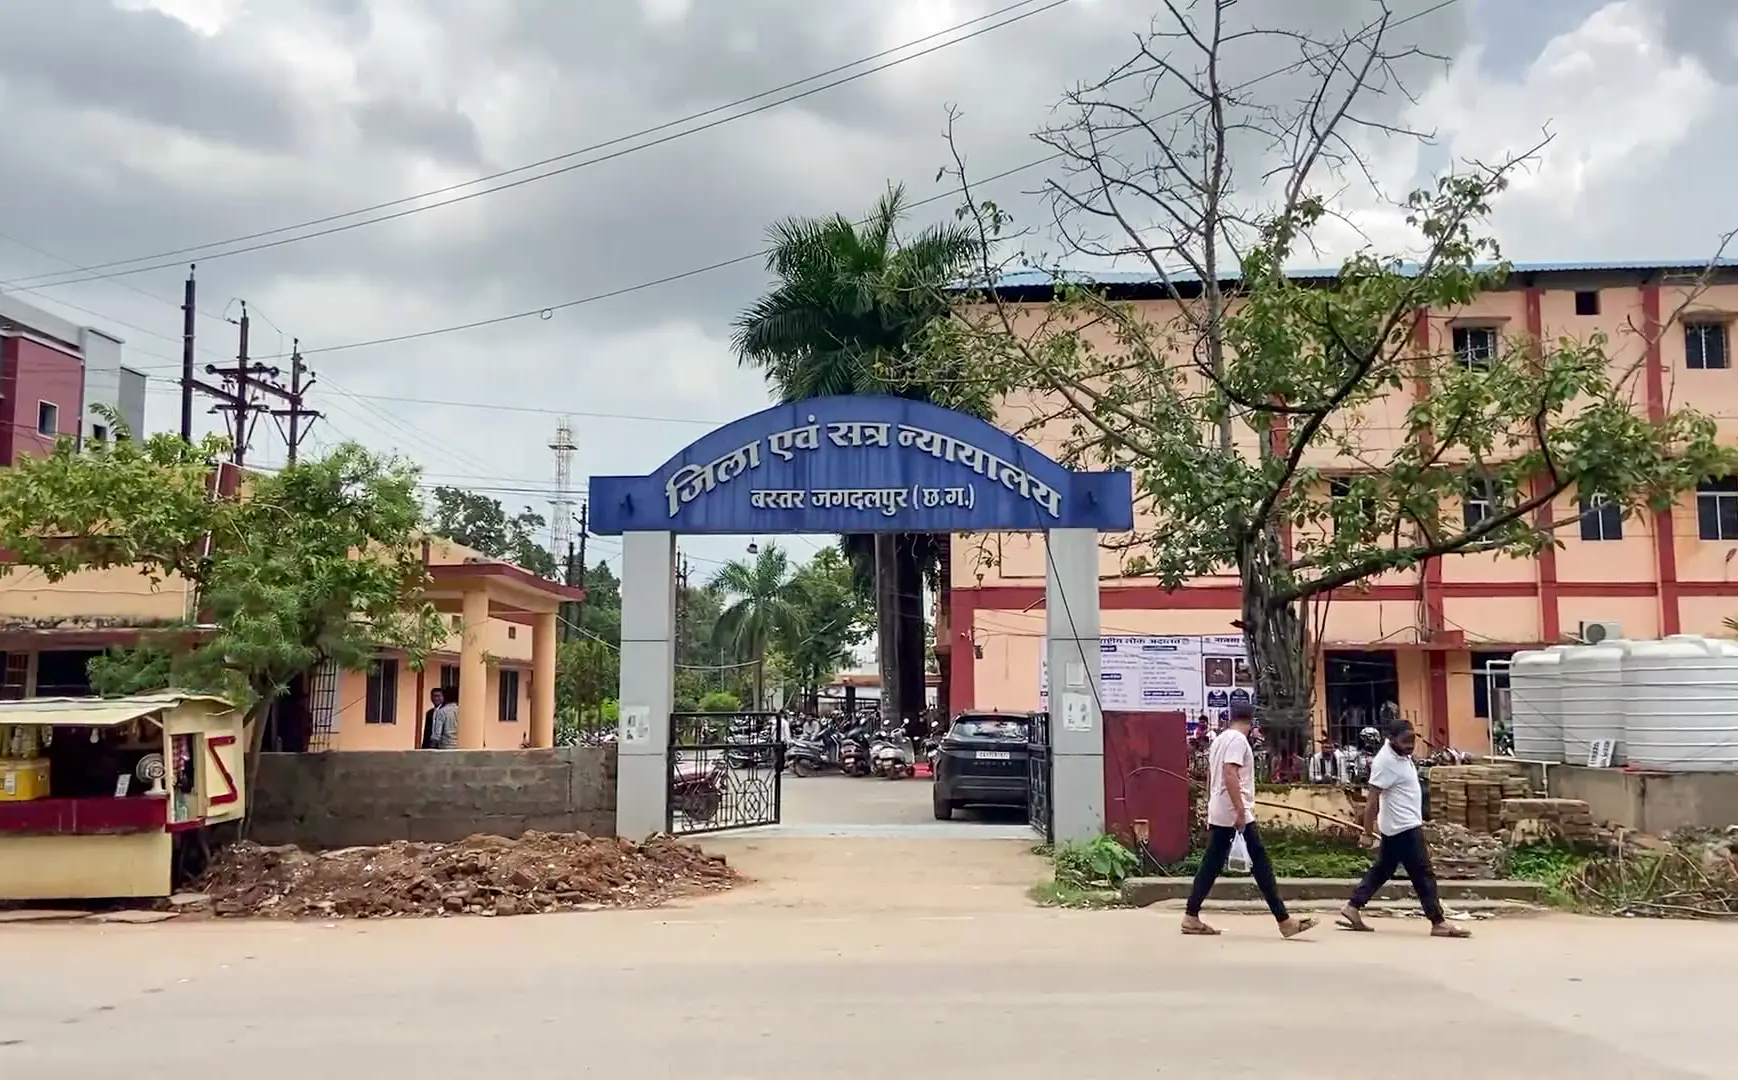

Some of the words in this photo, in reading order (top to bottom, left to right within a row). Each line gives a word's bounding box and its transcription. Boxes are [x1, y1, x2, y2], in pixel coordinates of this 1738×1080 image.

[665, 440, 762, 517] जिला
[768, 415, 820, 460] एवं
[827, 422, 890, 448] सत्र
[898, 424, 1061, 517] न्यायालय
[751, 488, 804, 509] बस्तर
[812, 488, 908, 515] जगदलपुर
[913, 485, 975, 510] (छ.ग.)
